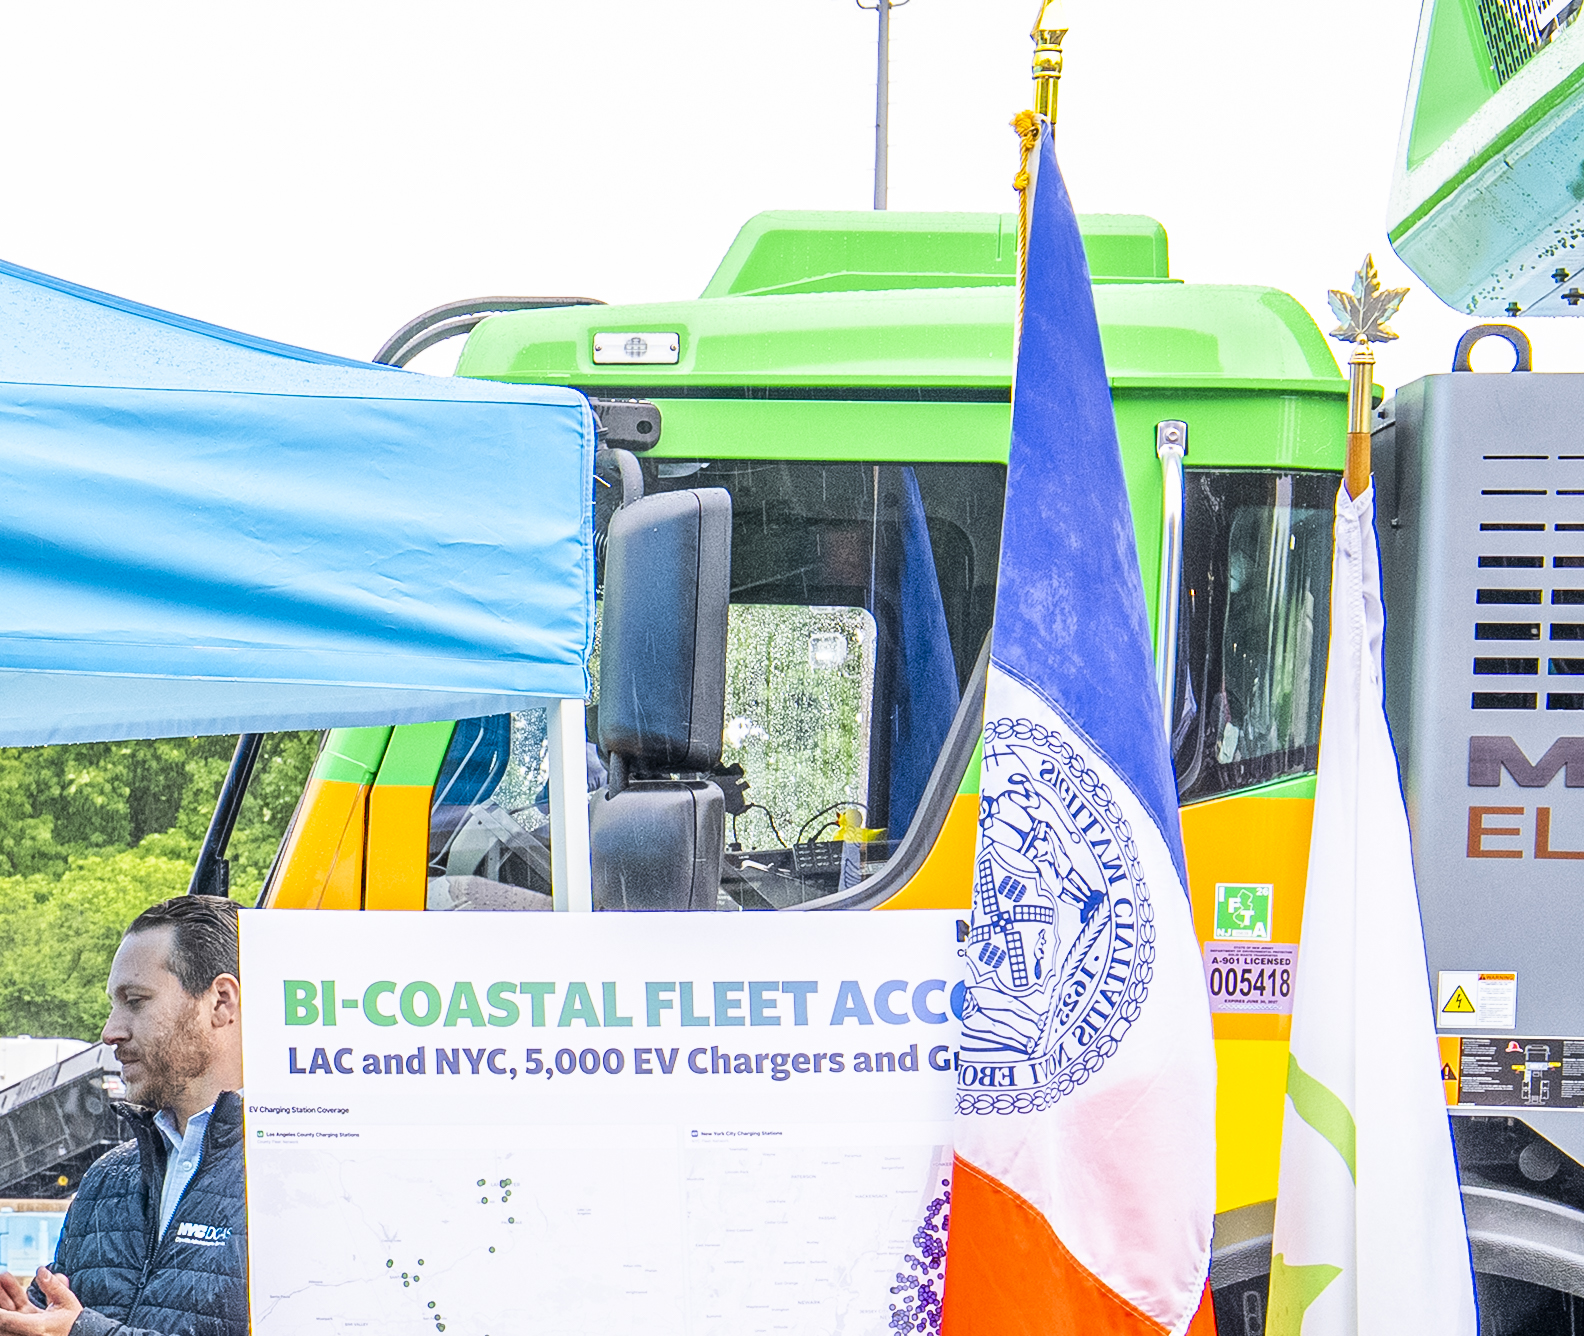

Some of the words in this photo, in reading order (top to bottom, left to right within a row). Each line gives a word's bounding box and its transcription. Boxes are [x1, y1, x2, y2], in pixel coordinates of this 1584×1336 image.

[1256, 888, 1268, 896] 26
[1217, 928, 1232, 936] NJ
[1210, 968, 1290, 997] 005418
[283, 979, 633, 1027] BI-COASTAL
[644, 980, 818, 1026] FLEET
[289, 1047, 354, 1074] LAC
[363, 1046, 426, 1074] and
[436, 1048, 517, 1080] NYC,
[526, 1048, 624, 1080] 5,000
[634, 1048, 679, 1074] EV
[688, 1046, 845, 1081] Chargers
[854, 1044, 919, 1072] and
[260, 1106, 290, 1114] Charging
[177, 1222, 207, 1238] NYC
